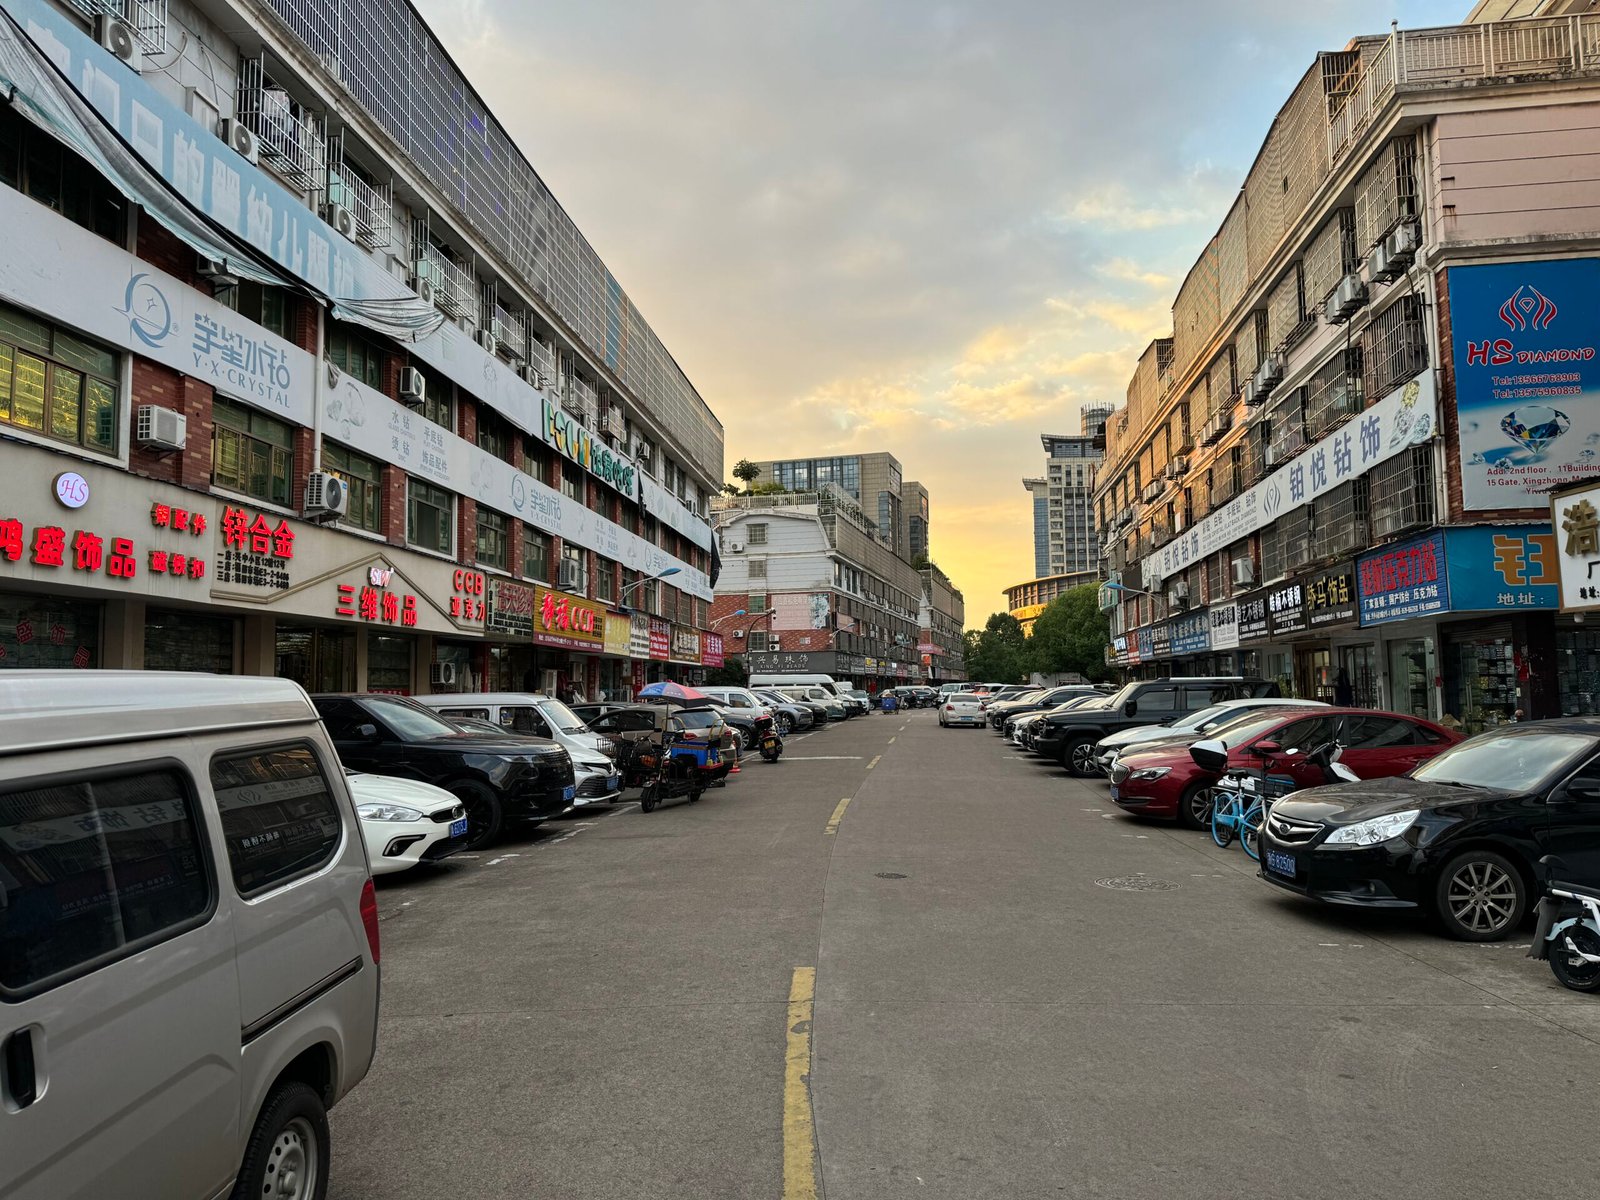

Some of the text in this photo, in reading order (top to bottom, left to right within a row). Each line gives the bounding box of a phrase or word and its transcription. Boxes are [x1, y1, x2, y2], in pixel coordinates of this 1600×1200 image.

[1467, 338, 1595, 367] HS DIAMOND
[1290, 415, 1381, 503] 铂悦钻饰
[222, 505, 296, 558] 锌合金
[454, 569, 483, 596] CCB
[336, 584, 417, 627] 三维饰品
[450, 597, 486, 621] 亚克力
